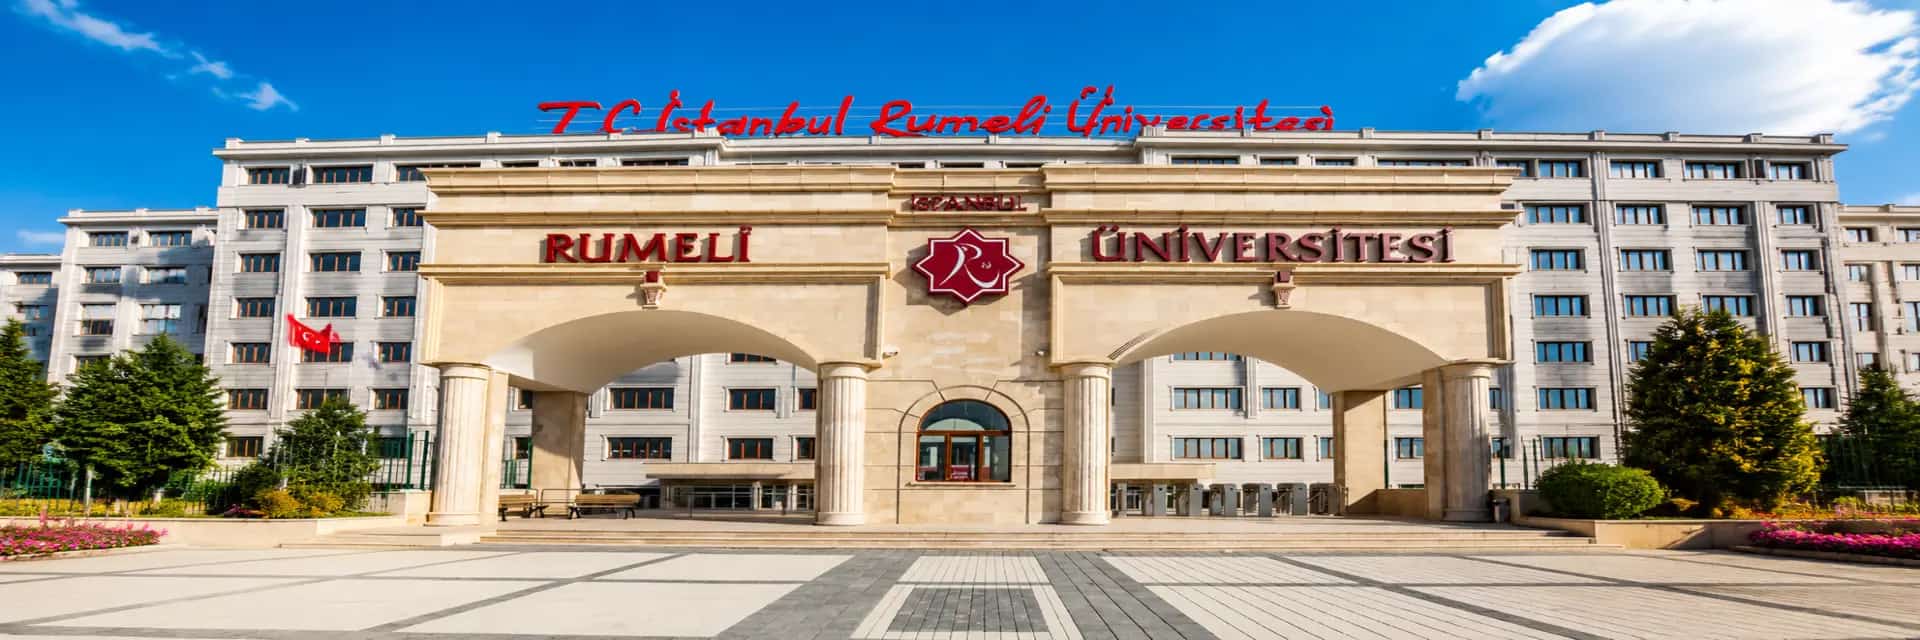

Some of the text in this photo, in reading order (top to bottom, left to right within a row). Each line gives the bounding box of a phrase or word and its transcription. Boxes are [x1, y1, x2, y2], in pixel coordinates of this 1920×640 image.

[870, 96, 1052, 139] Rumeli
[544, 224, 1456, 263] RUMELİ ÜNİVERSİTESİ
